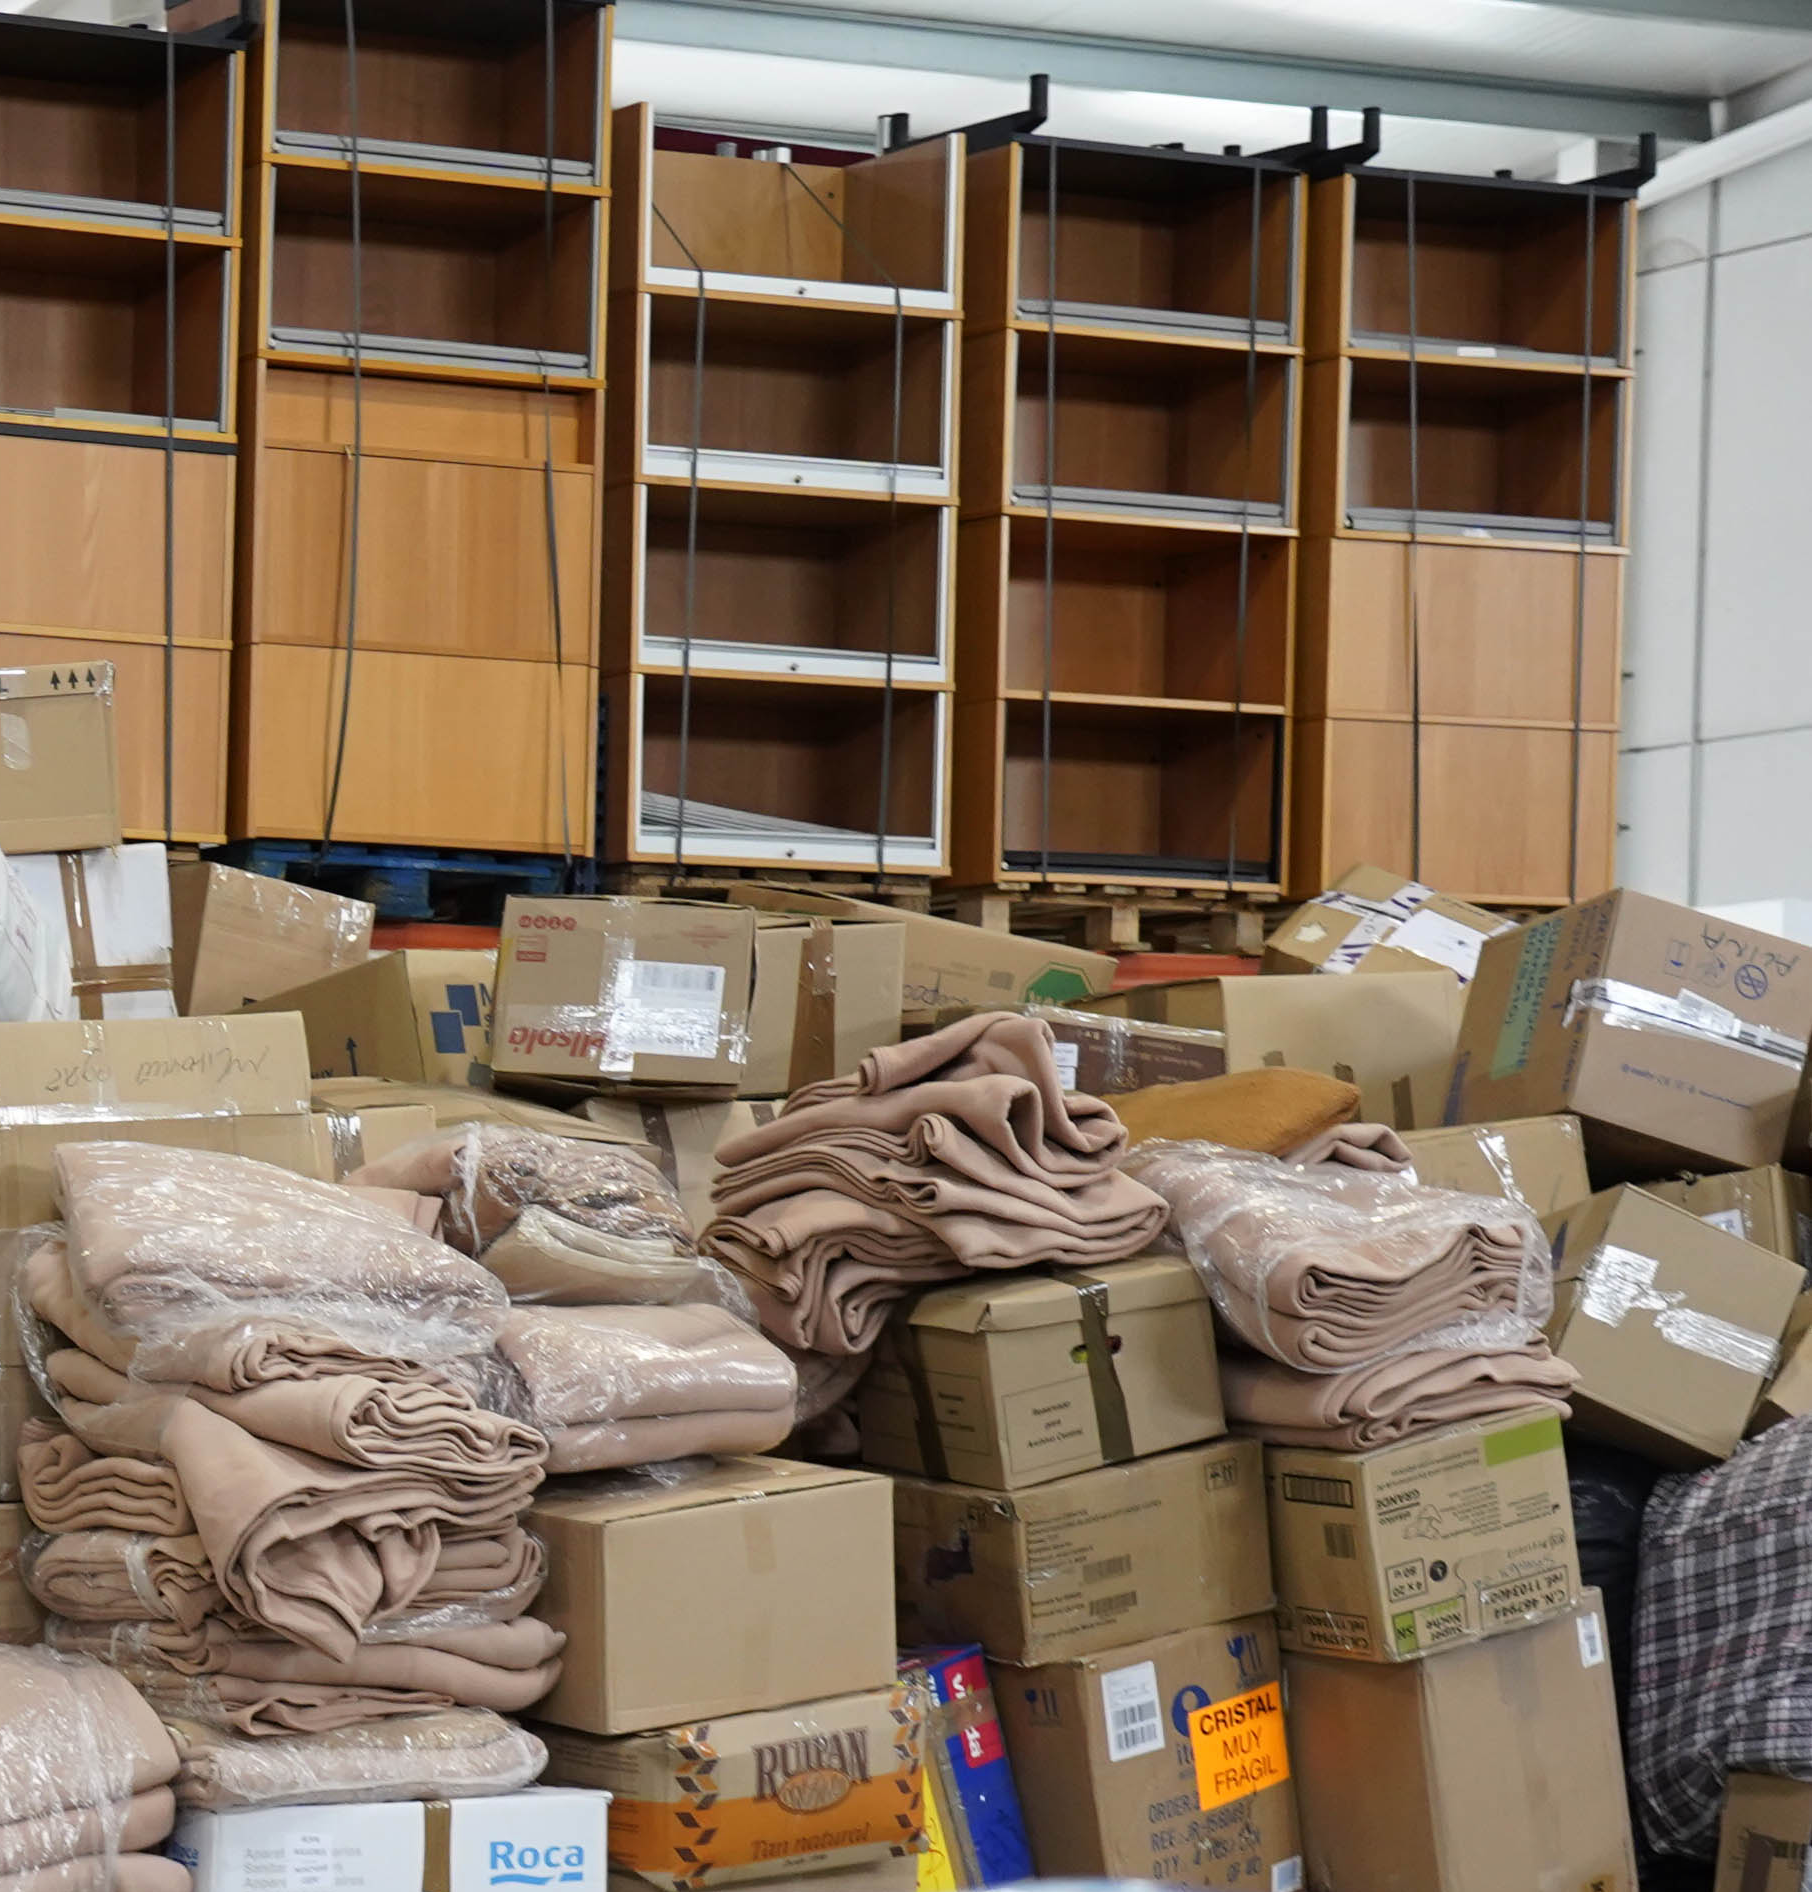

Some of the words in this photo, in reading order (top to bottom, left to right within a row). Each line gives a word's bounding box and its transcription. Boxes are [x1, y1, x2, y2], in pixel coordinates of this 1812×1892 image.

[1199, 1692, 1277, 1736] CRISTAL
[1222, 1725, 1262, 1760] MUY
[489, 1840, 585, 1870] Roca
